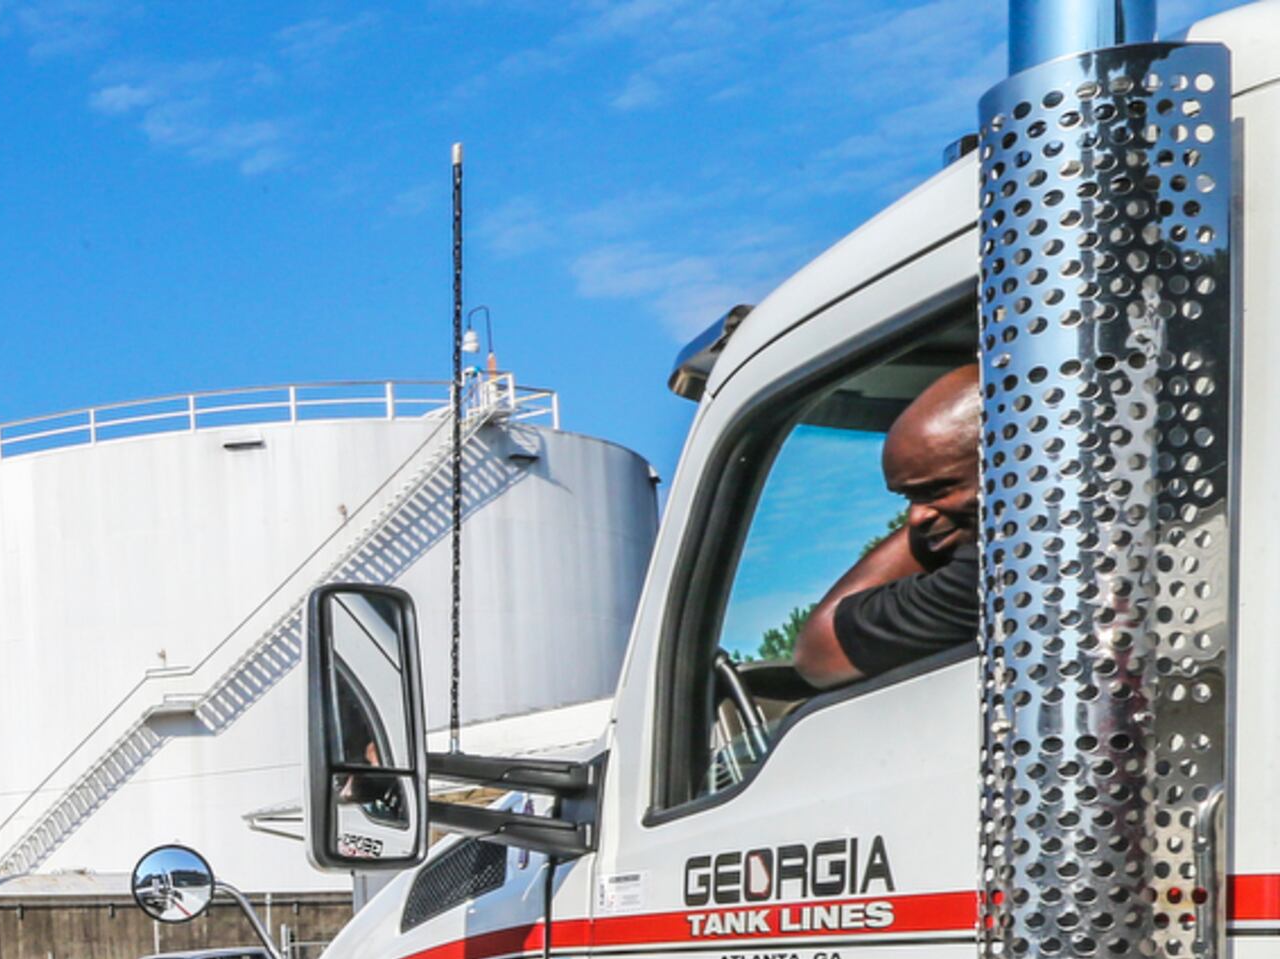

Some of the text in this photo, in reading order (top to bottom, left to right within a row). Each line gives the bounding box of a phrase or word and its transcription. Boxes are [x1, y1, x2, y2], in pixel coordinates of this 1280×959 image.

[684, 835, 895, 907] GEORGIA
[687, 901, 895, 937] TANK LINES
